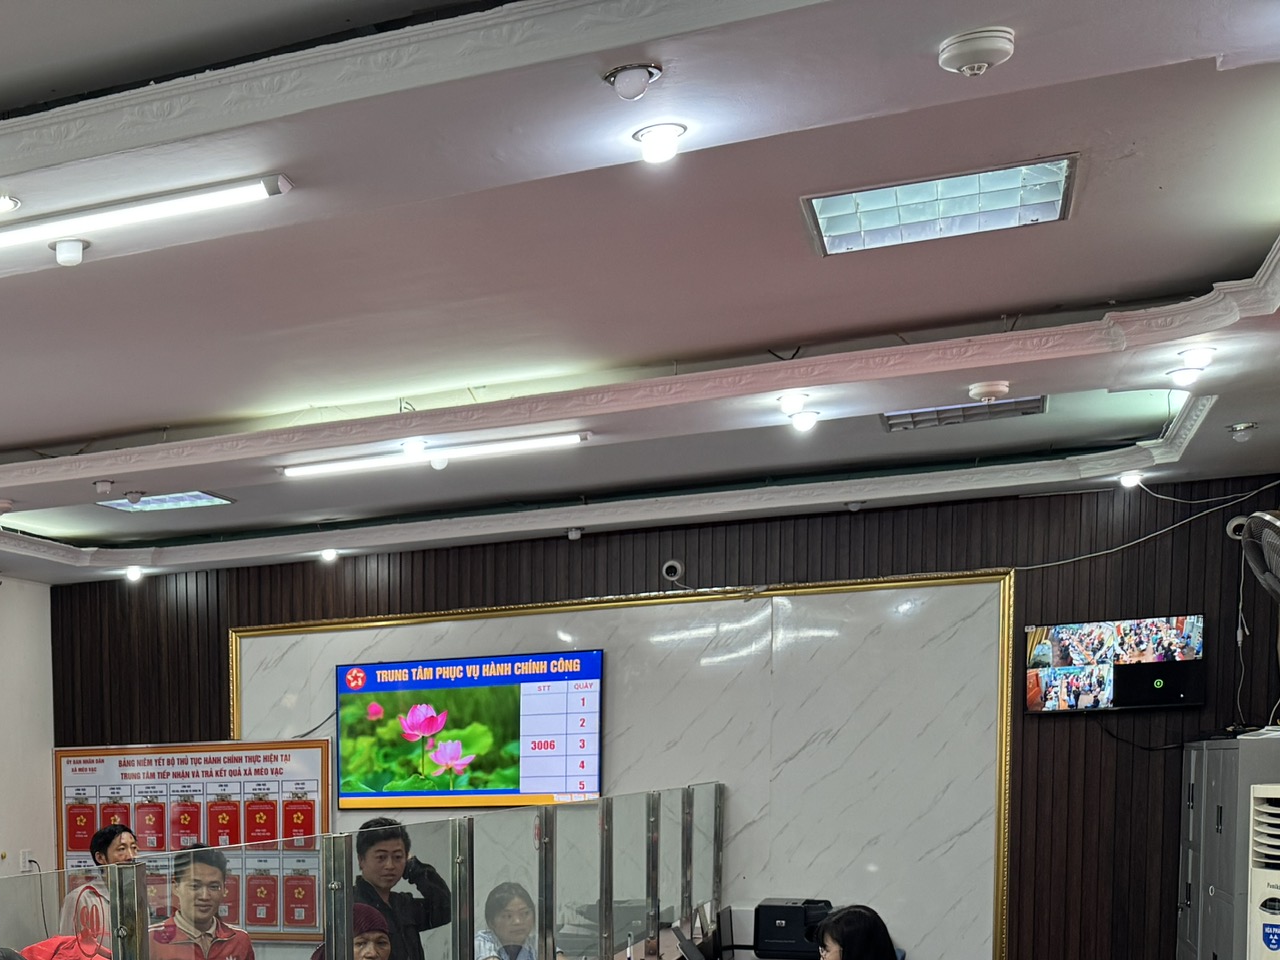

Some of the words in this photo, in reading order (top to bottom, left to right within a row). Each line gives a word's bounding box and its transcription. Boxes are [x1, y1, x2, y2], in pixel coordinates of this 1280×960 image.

[375, 669, 409, 683] TRUNG
[411, 665, 433, 680] TÂM
[435, 666, 463, 681] PHỤC
[466, 665, 480, 680] VỤ
[482, 661, 512, 677] HÀNH
[514, 659, 547, 675] CHÍNH
[550, 657, 580, 673] CÔNG
[581, 697, 585, 707] 1
[579, 718, 585, 728] 2
[531, 740, 556, 751] 3006
[579, 739, 585, 749] 3
[118, 757, 135, 768] BẢNG
[136, 757, 153, 767] NIÊM
[154, 756, 165, 766] YẾT
[166, 757, 176, 767] BỘ
[177, 755, 189, 765] THỦ
[190, 757, 202, 766] TỤC
[203, 755, 222, 765] HÀNH
[223, 754, 243, 764] CHÍNH
[245, 755, 261, 765] THỰC
[262, 753, 279, 764] HIỆN
[280, 753, 291, 764] TẠI
[579, 760, 585, 769] 4
[121, 772, 141, 780] TRUNG
[142, 770, 156, 779] TÂM
[157, 770, 171, 779] TIẾP
[172, 770, 190, 780] NHẬN
[191, 769, 200, 778] VÀ
[201, 768, 214, 778] TRẢ
[215, 767, 227, 777] KẾT
[228, 766, 242, 777] QUẢ
[243, 767, 252, 776] XÃ
[254, 767, 269, 776] MÈO
[270, 767, 283, 777] VẠC
[579, 781, 585, 790] 5
